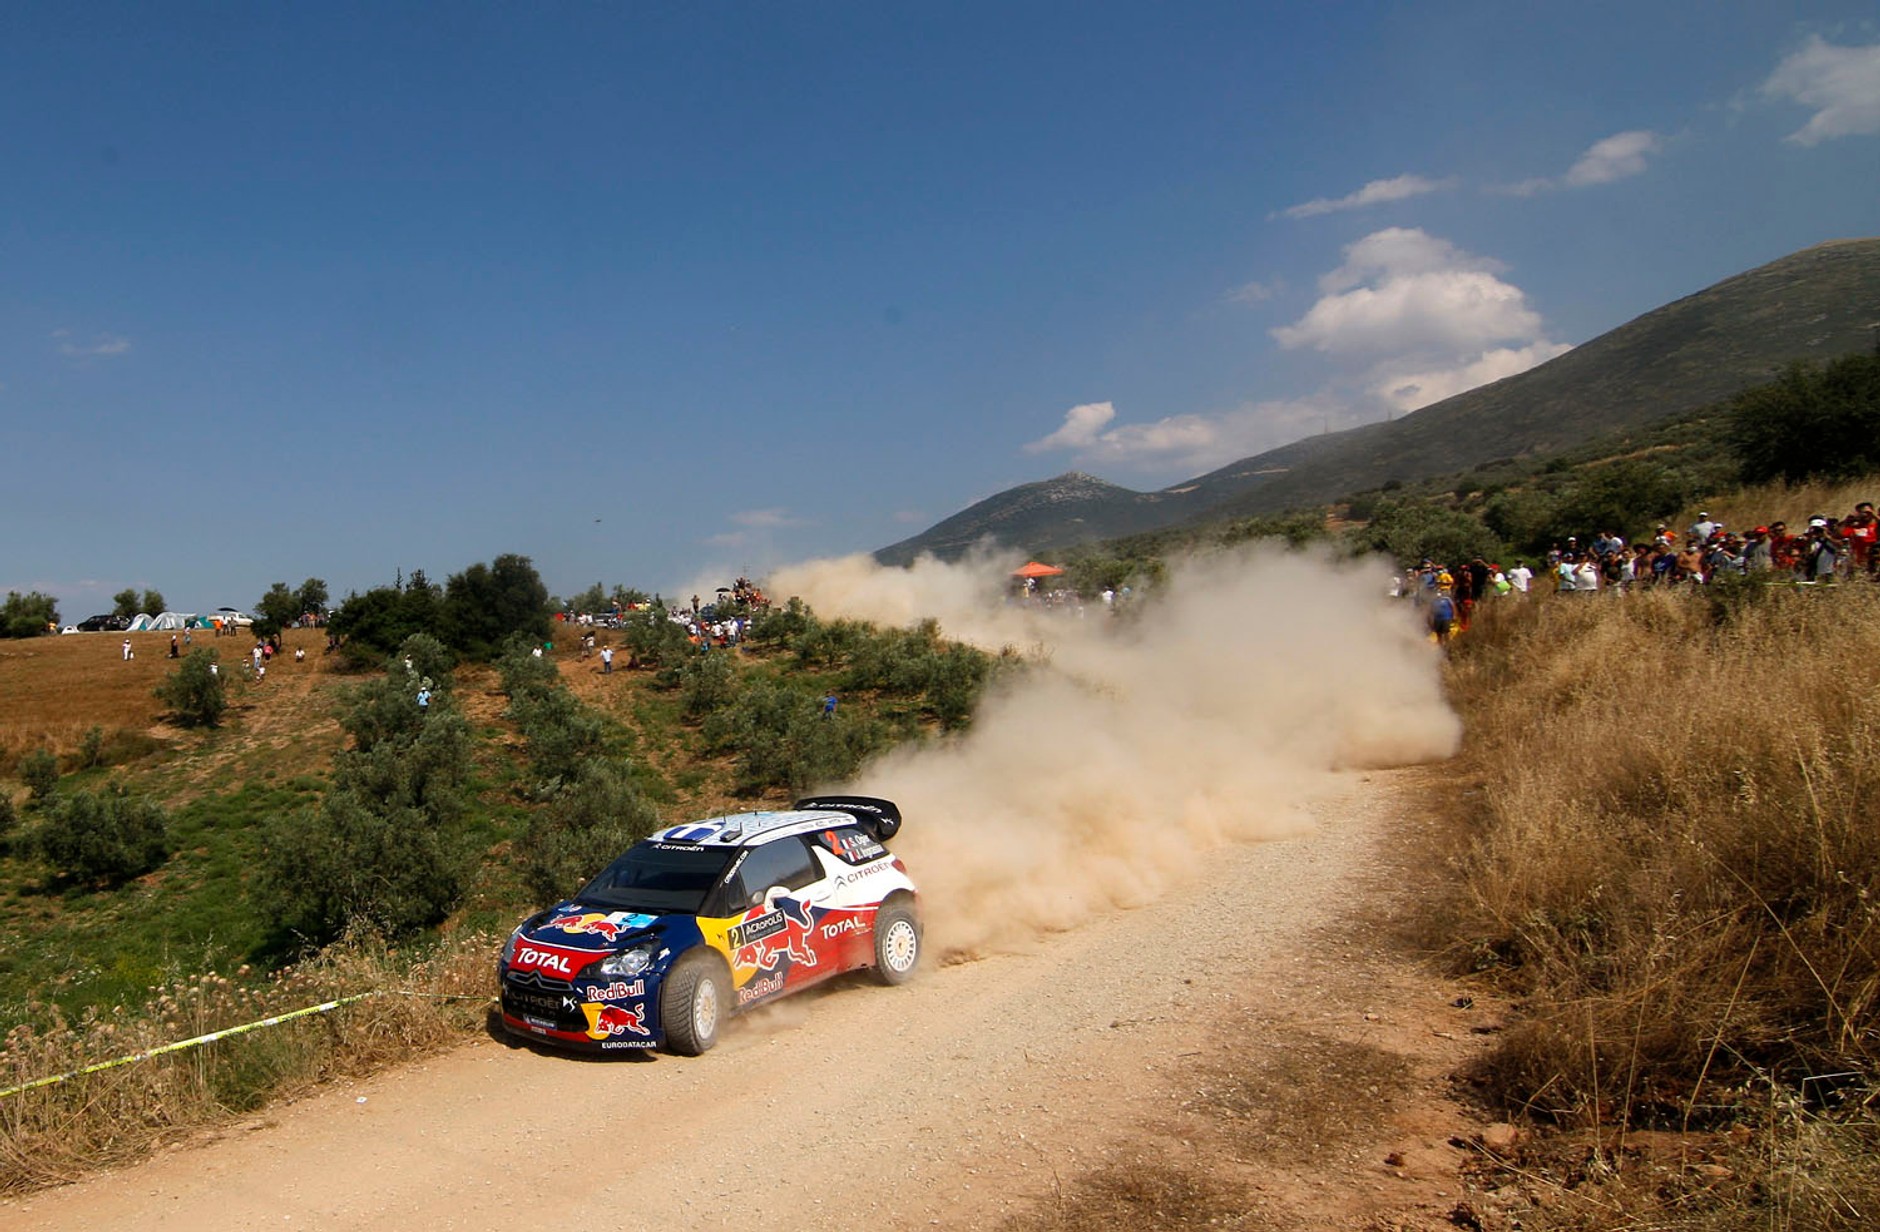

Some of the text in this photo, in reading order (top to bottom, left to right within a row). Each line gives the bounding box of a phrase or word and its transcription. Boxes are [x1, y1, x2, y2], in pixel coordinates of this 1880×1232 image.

[825, 830, 845, 855] 2
[746, 912, 783, 935] ACROPOLIS
[820, 916, 866, 939] TOTAL
[731, 928, 741, 949] 2
[517, 947, 572, 974] TOTAL
[601, 1041, 657, 1049] EURODATACAR
